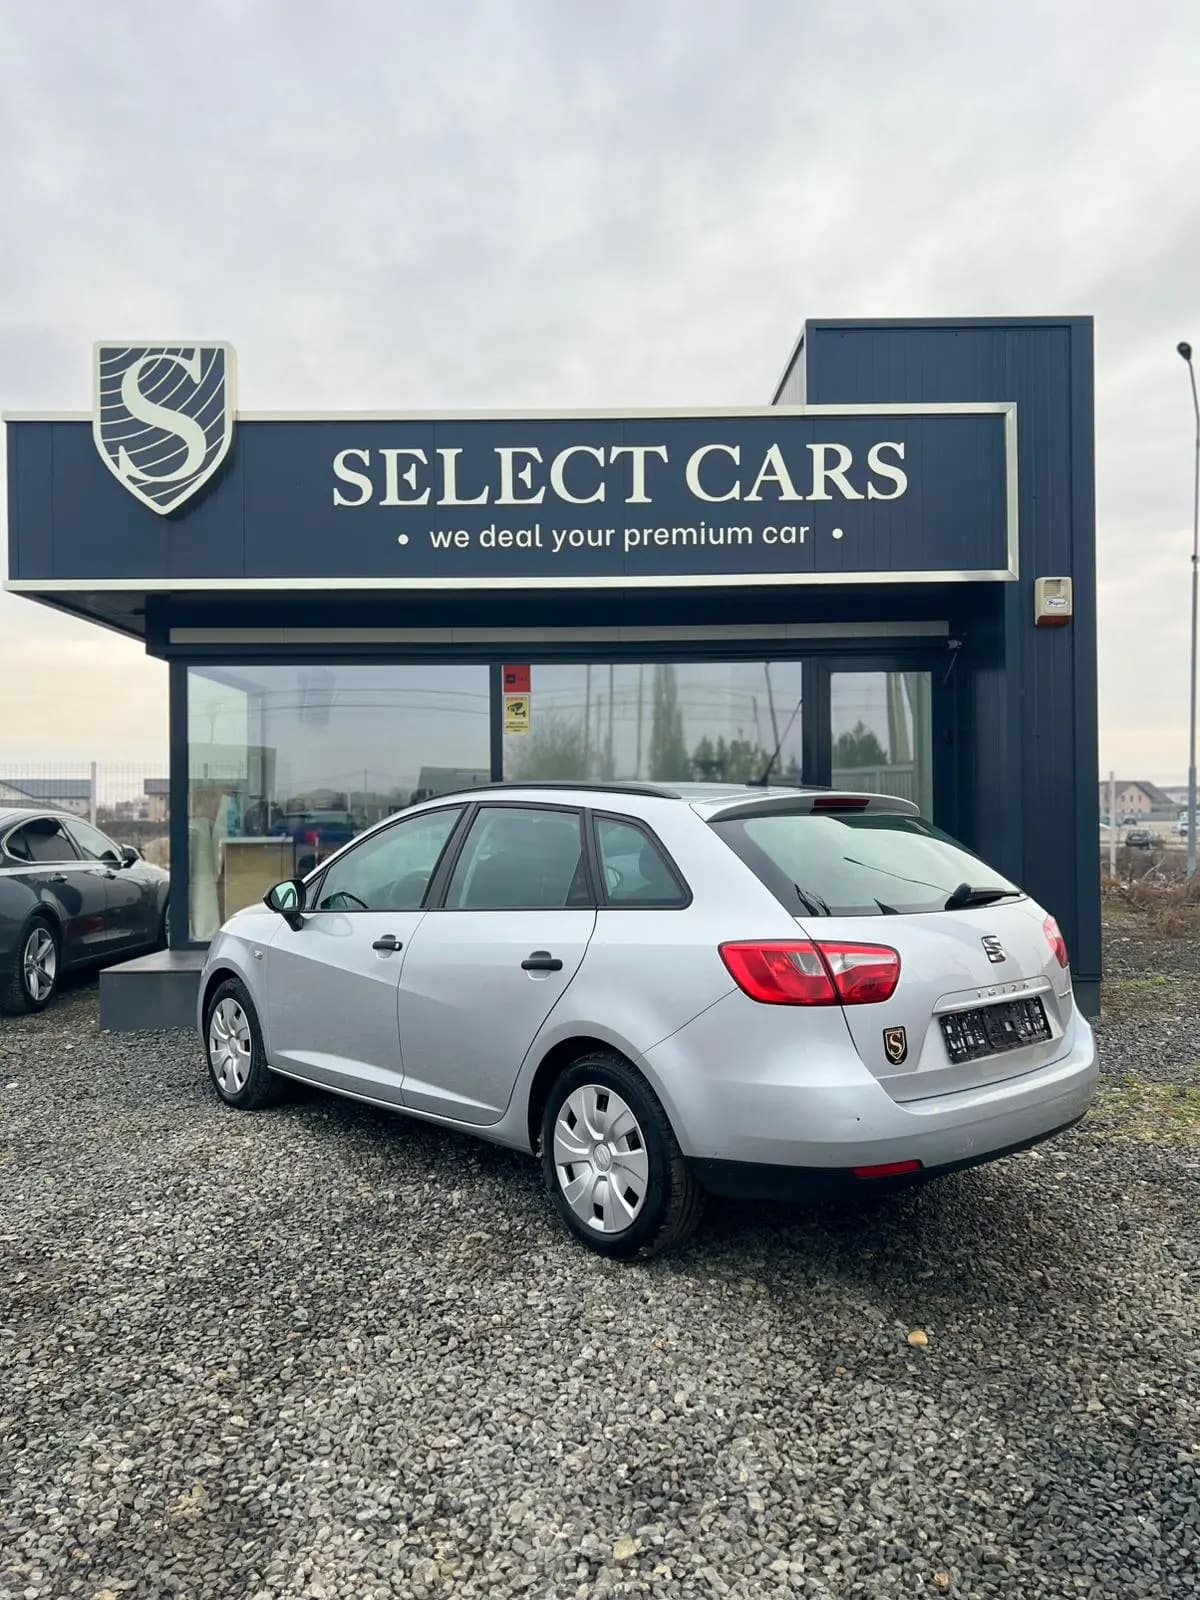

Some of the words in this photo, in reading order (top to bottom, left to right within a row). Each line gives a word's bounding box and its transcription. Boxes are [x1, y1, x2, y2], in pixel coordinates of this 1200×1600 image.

[332, 445, 669, 507] SELECT
[685, 442, 908, 502] CARS
[429, 530, 470, 548] we
[479, 523, 543, 548] deal
[551, 529, 616, 553] your
[624, 521, 753, 553] premium
[762, 526, 810, 544] car
